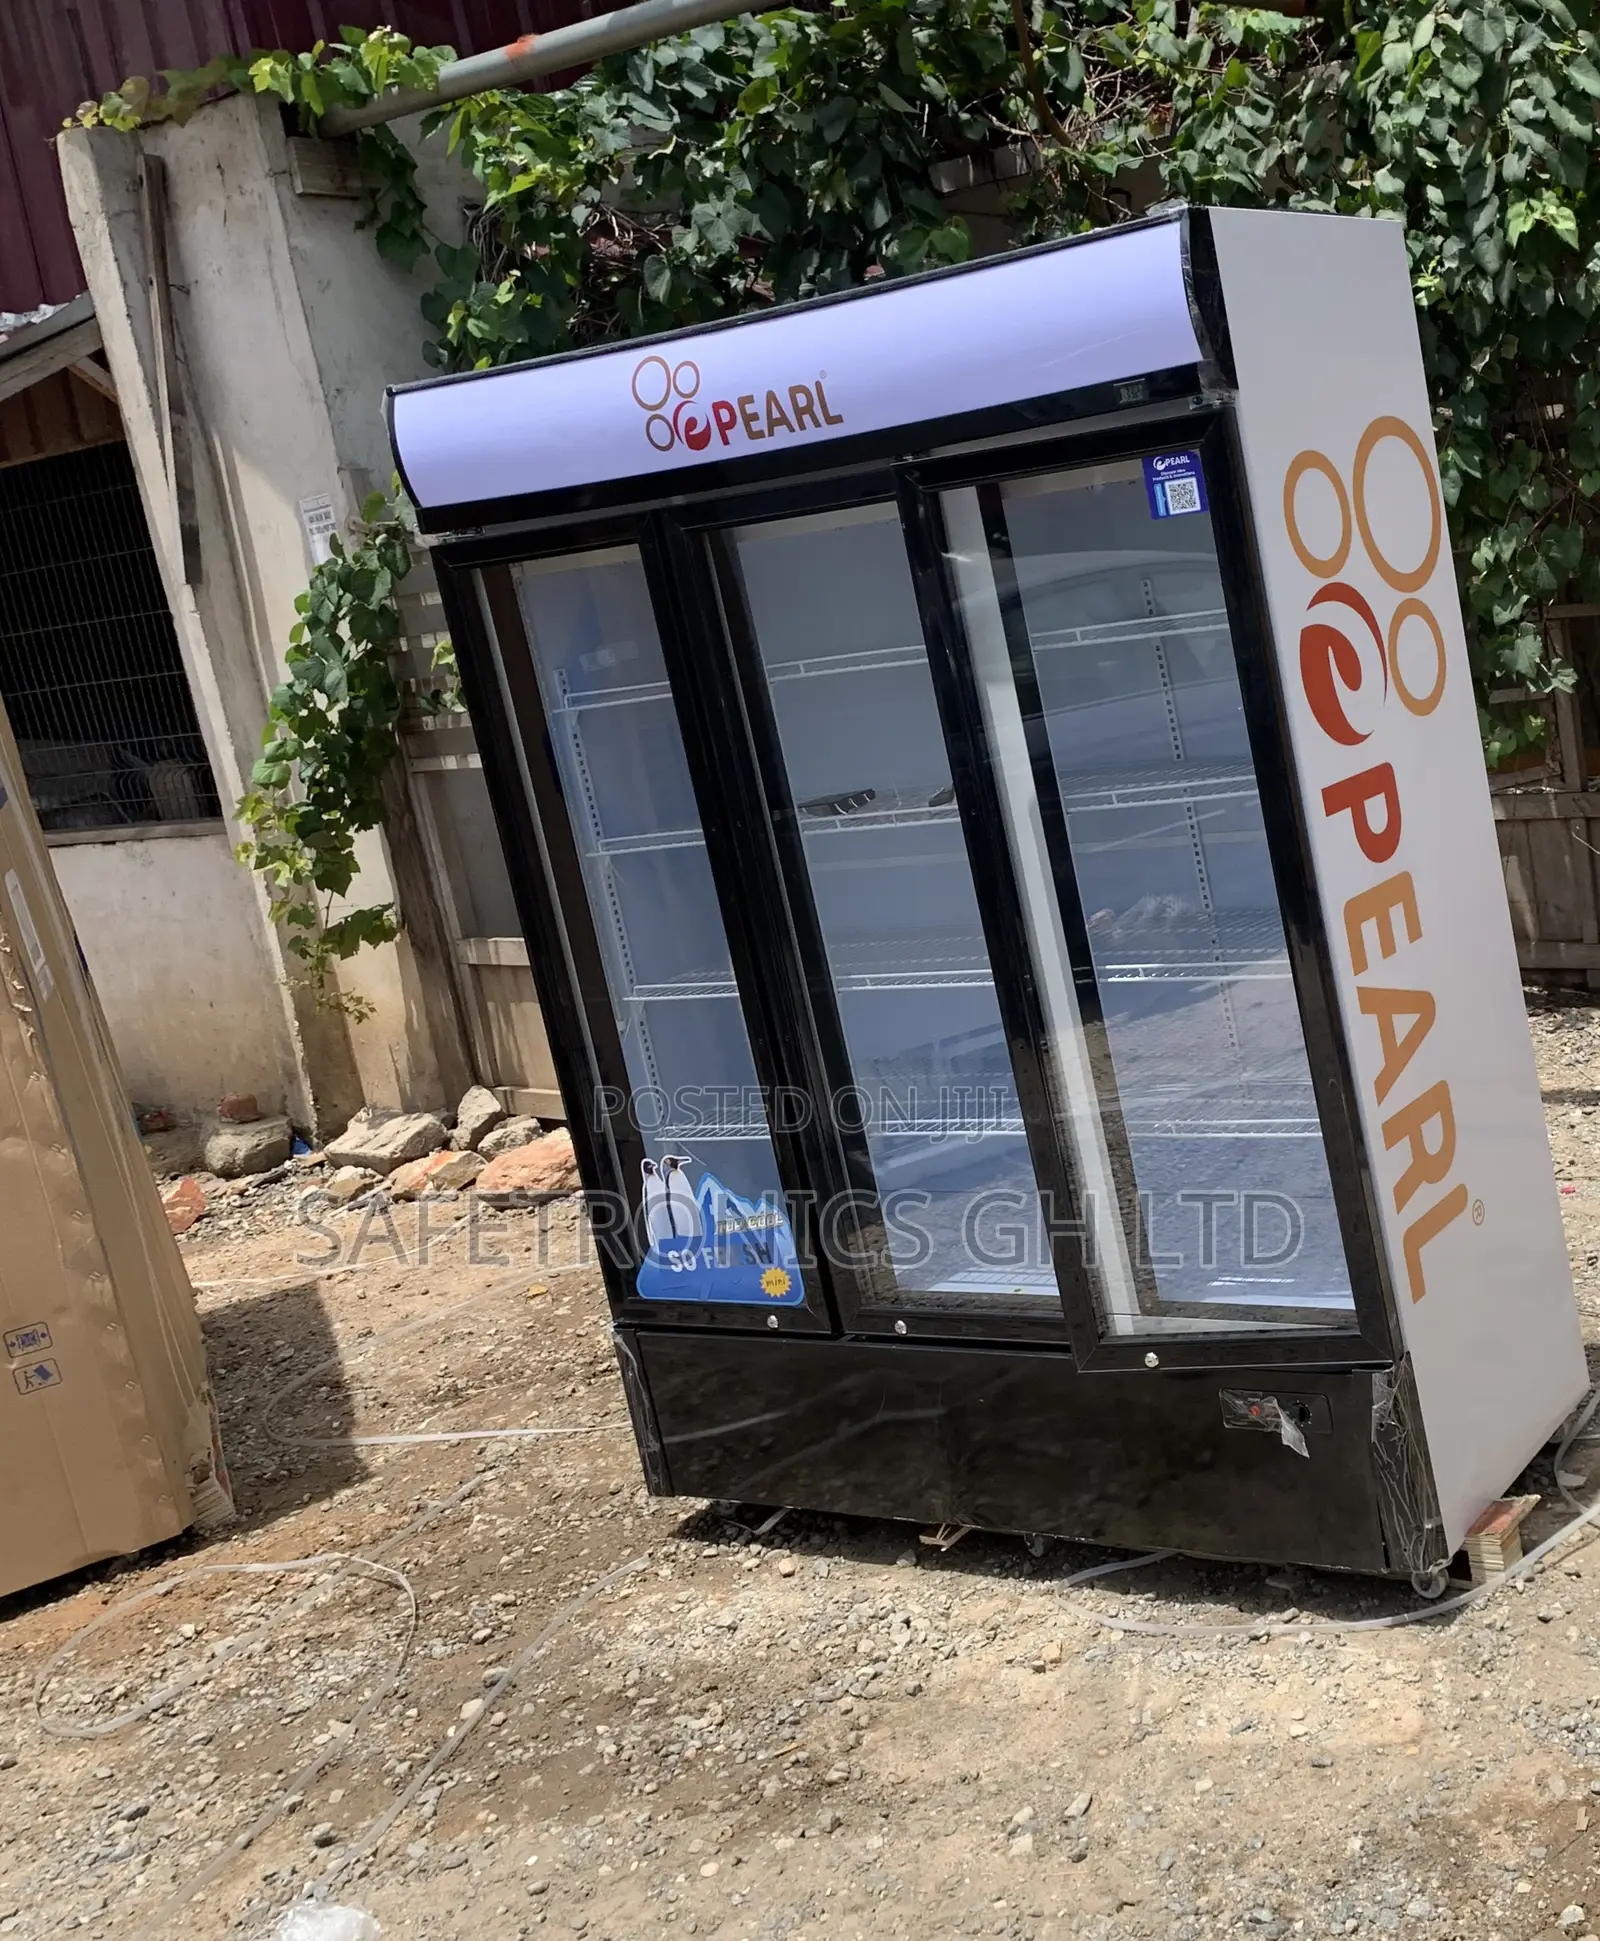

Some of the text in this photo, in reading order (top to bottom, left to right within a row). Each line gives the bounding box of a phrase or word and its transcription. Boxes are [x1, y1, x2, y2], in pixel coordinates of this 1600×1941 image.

[711, 380, 844, 446] PEARL
[1320, 761, 1469, 1304] PEARL
[747, 1213, 784, 1230] COOL
[667, 1248, 697, 1273] SO
[765, 1275, 786, 1287] mini
